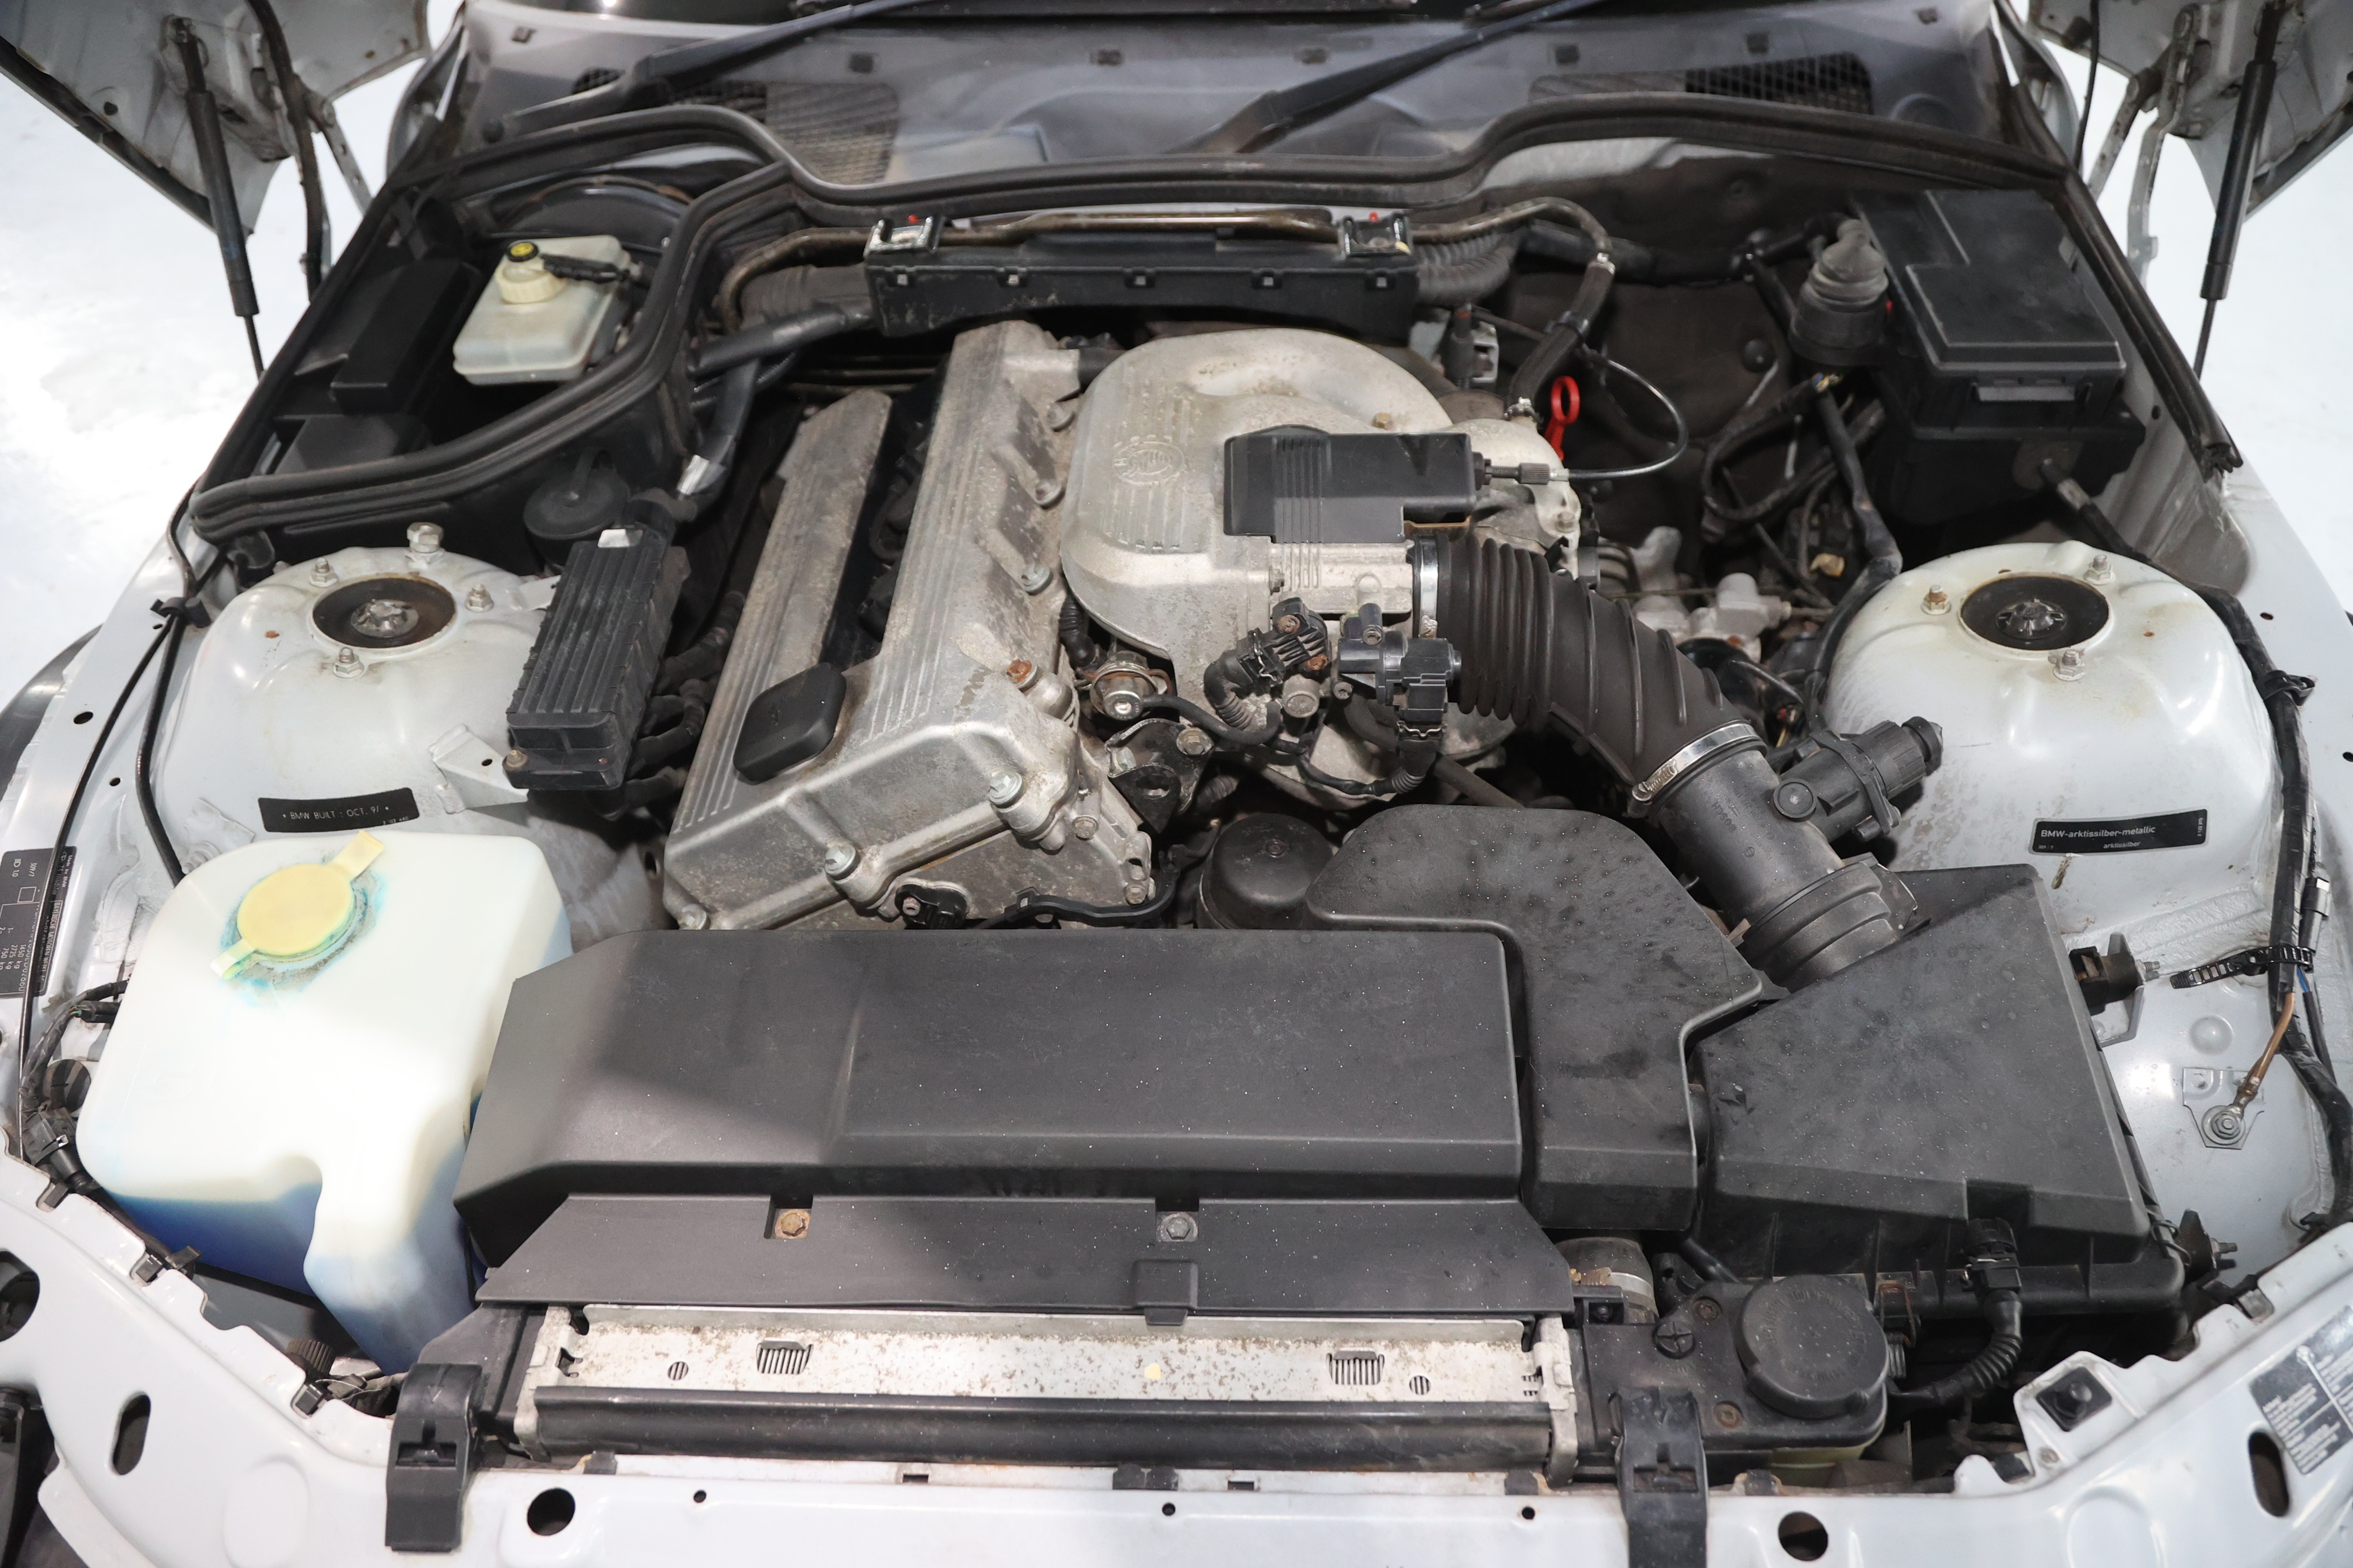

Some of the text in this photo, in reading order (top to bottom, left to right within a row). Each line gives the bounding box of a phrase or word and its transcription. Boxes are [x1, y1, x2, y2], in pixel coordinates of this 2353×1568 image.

[290, 810, 310, 820] BMW
[314, 810, 336, 819] BUILT
[2041, 825, 2157, 838] BMW-arktissilber-metallic
[2103, 840, 2141, 849] arktissilber
[1, 948, 9, 959] 750
[9, 944, 18, 958] 2725
[14, 944, 26, 969] 1450 kg
[5, 960, 14, 970] kg
